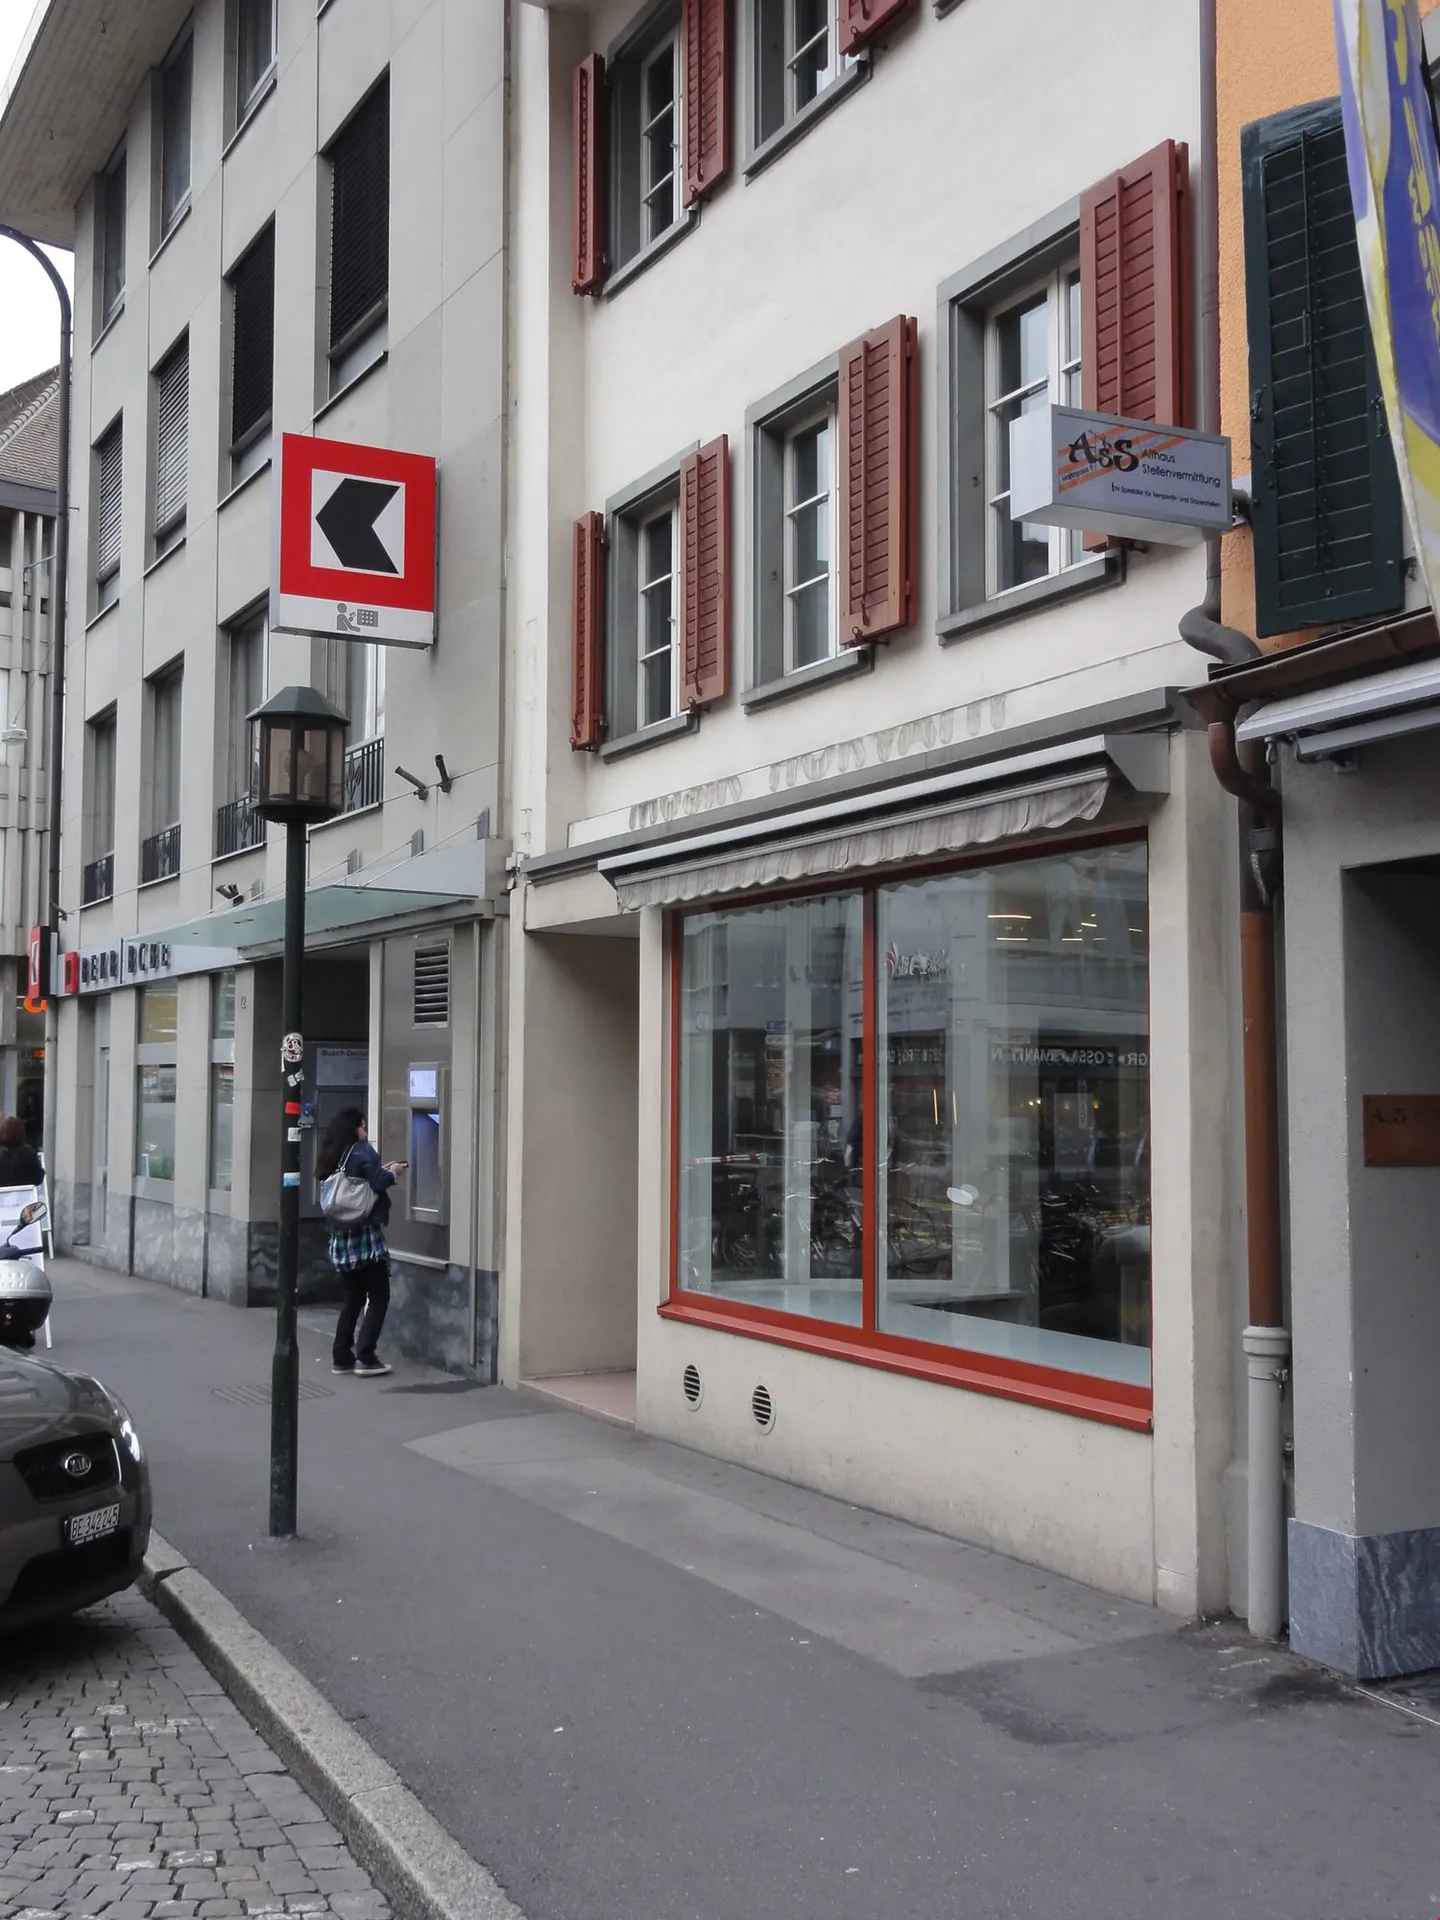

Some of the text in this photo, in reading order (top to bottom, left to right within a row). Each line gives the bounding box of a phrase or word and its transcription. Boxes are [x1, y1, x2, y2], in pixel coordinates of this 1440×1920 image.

[1143, 448, 1176, 464] Althaus
[1142, 464, 1221, 488] Stellenvermittlung
[128, 943, 171, 975] BCBE
[69, 1457, 88, 1472] KIA
